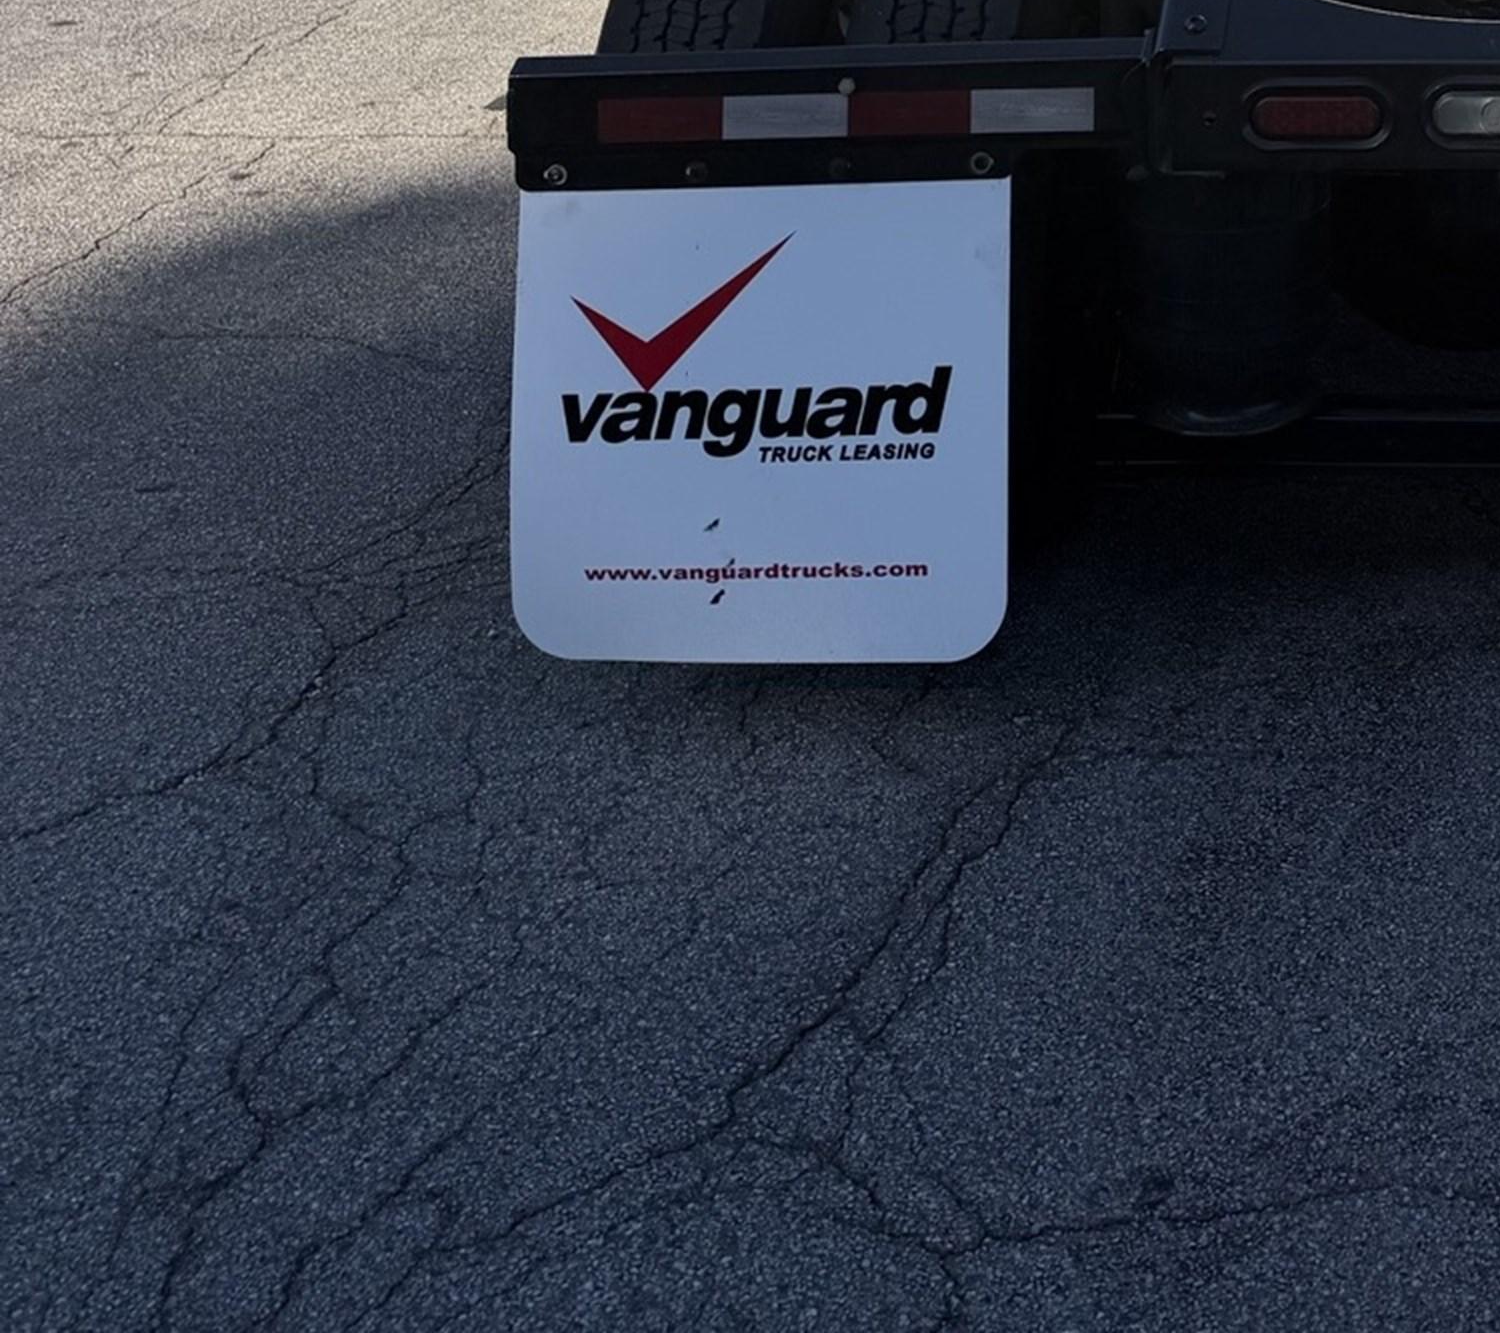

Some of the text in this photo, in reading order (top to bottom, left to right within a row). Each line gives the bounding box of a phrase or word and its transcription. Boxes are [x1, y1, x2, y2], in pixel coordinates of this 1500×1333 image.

[560, 365, 953, 458] vanguard
[759, 442, 936, 463] TRUCK LEASING
[584, 562, 930, 584] www.vanguardtrucks.com
